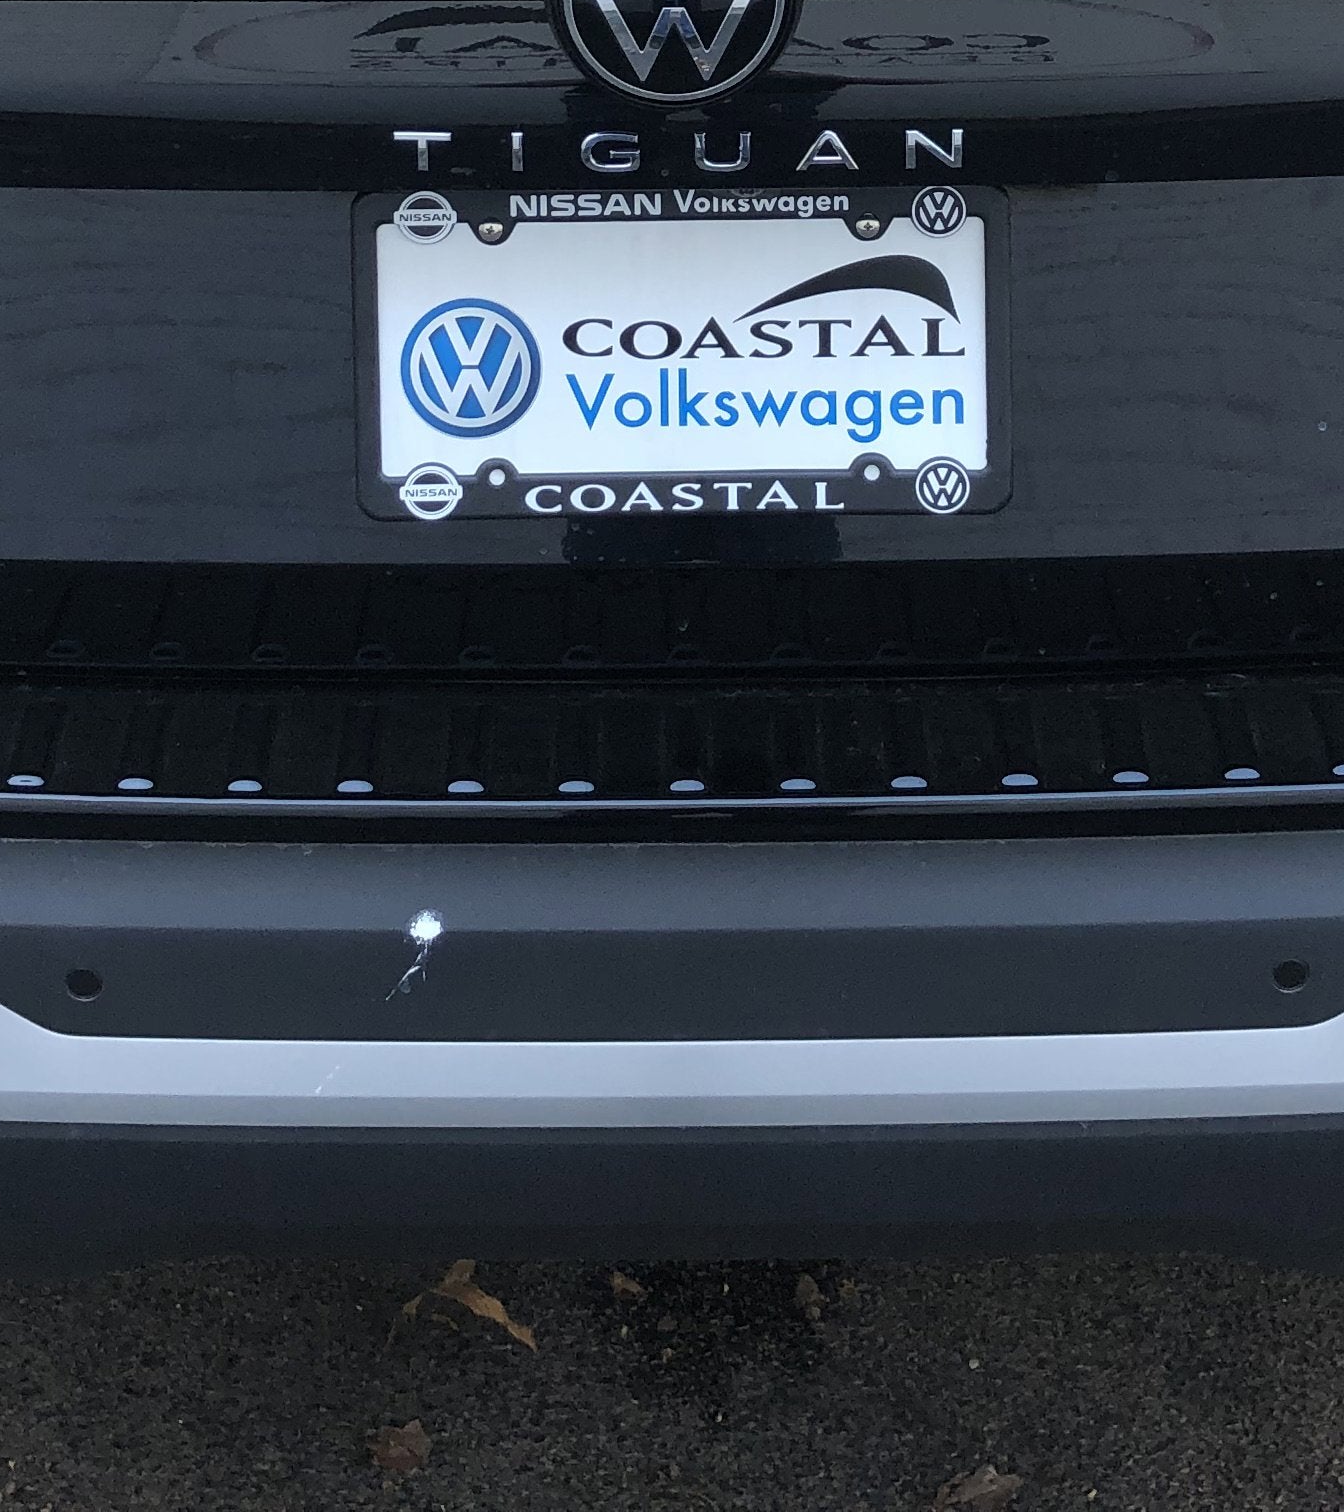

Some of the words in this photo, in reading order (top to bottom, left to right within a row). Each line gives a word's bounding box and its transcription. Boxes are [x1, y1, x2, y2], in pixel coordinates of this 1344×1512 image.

[393, 128, 964, 173] TIGUAN
[398, 213, 453, 222] NISSAN
[509, 193, 662, 217] NISSAN
[673, 188, 850, 218] Volkswagen
[562, 314, 966, 360] COASTAL
[564, 367, 966, 443] Volkswagen
[404, 488, 459, 498] NISSAN
[524, 480, 845, 513] COASTAL
